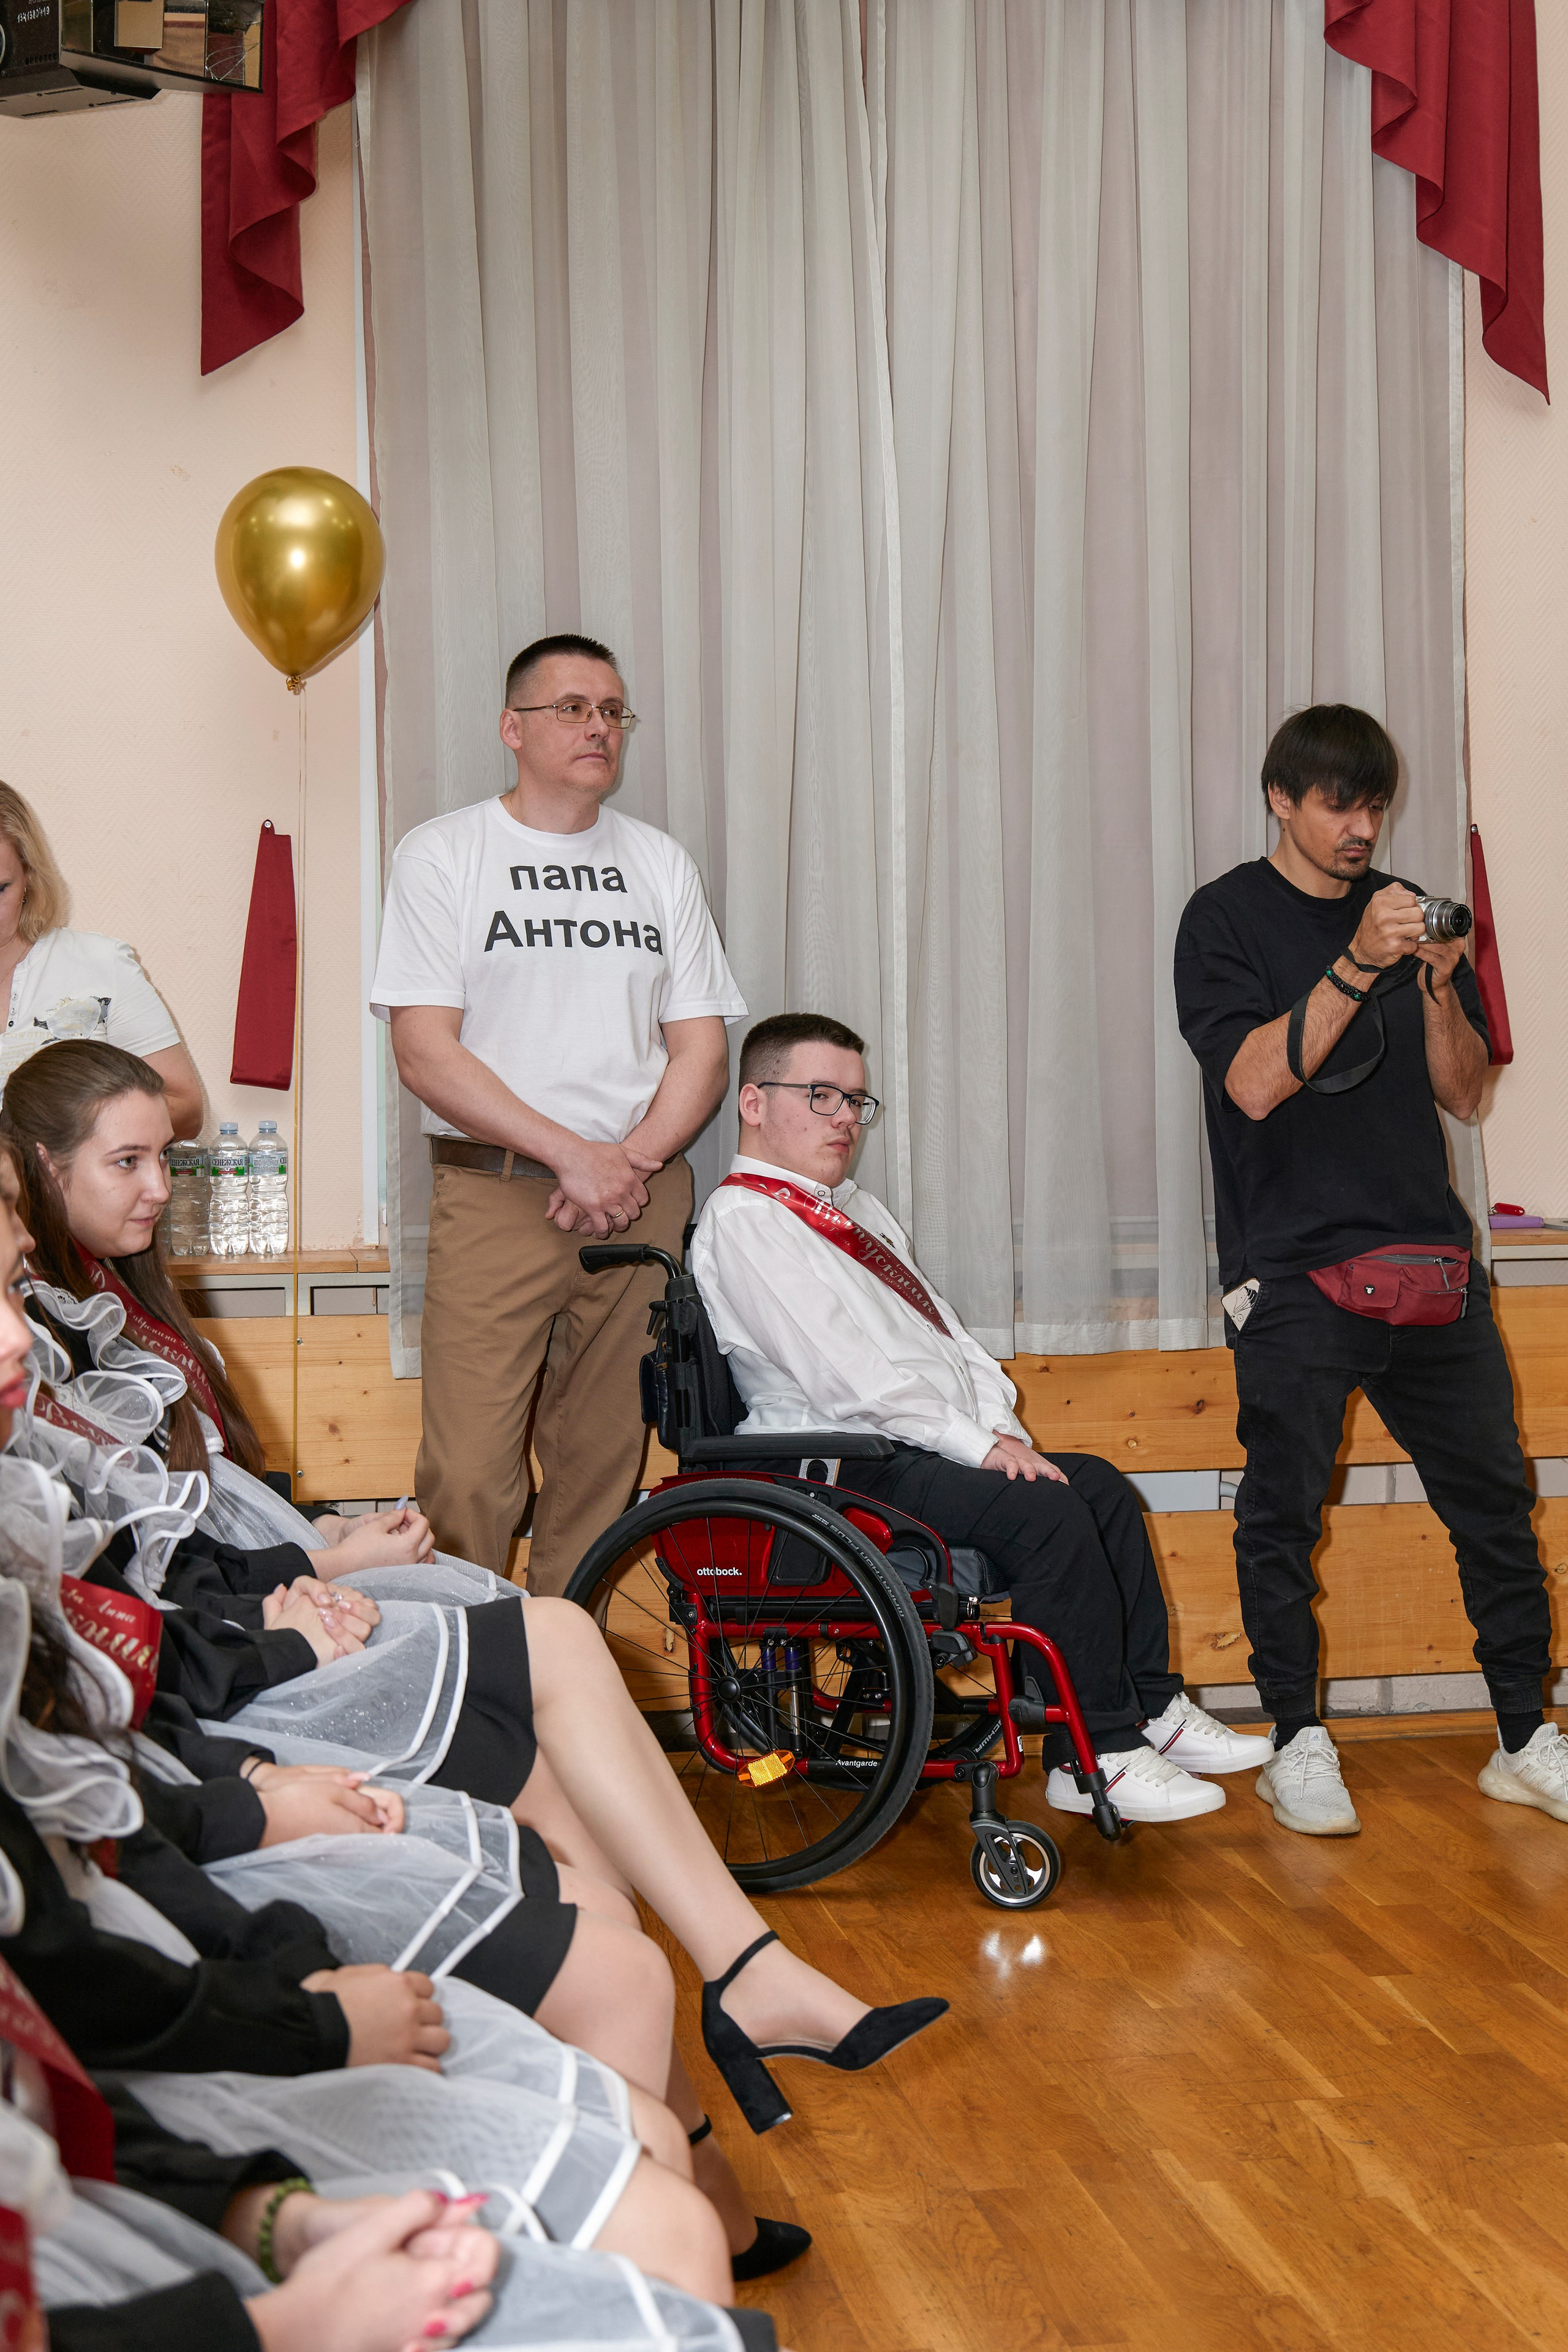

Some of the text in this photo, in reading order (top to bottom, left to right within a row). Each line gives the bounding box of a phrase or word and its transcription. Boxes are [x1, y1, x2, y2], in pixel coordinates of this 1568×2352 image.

[510, 865, 628, 893] папа
[484, 911, 663, 956] Антона
[804, 1194, 935, 1314] Выпускник
[830, 1524, 905, 1618] MARATHON PLUS
[835, 1759, 878, 1768] Avantgarde
